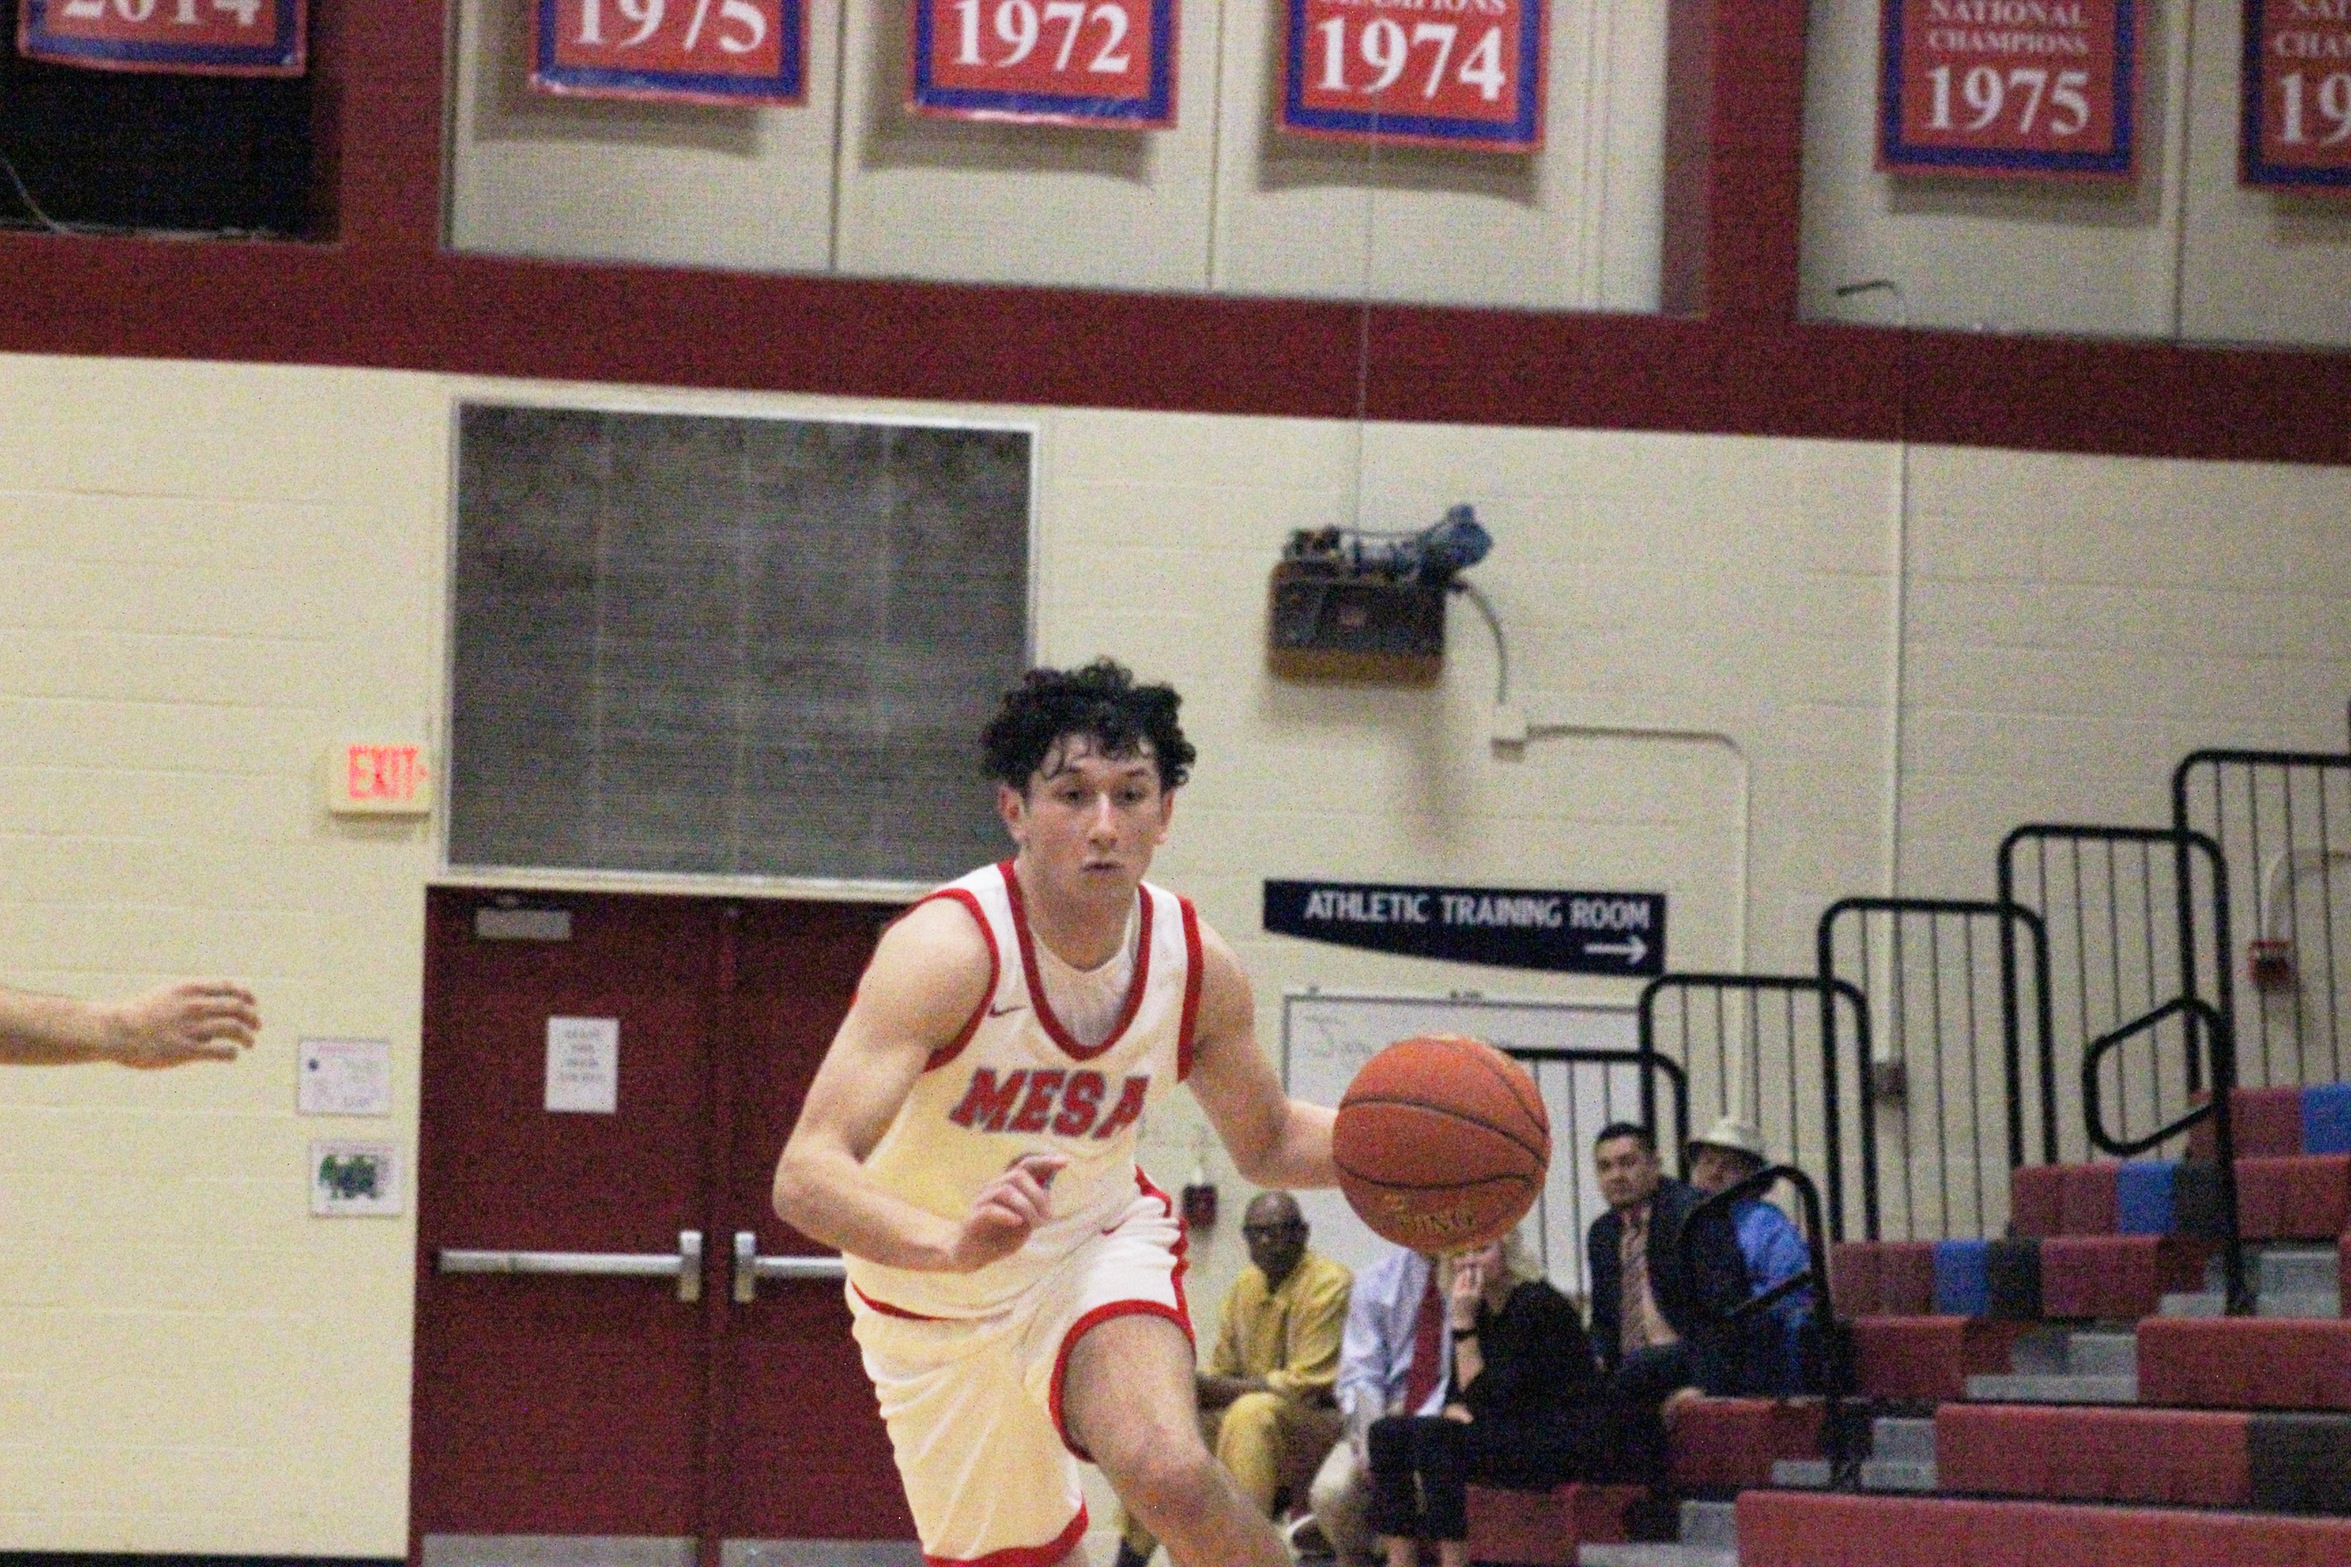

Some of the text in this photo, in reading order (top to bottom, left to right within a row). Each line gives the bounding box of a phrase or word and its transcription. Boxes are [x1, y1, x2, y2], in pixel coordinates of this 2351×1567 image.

[953, 0, 1130, 73] 1972
[1315, 16, 1507, 100] 1974
[1928, 29, 2089, 56] CHAMPIONS
[1924, 65, 2091, 136] 1975
[348, 745, 418, 800] EXIT
[1303, 889, 1651, 929] ATHLETIC TRAINING ROOM
[949, 1066, 1151, 1140] MESA
